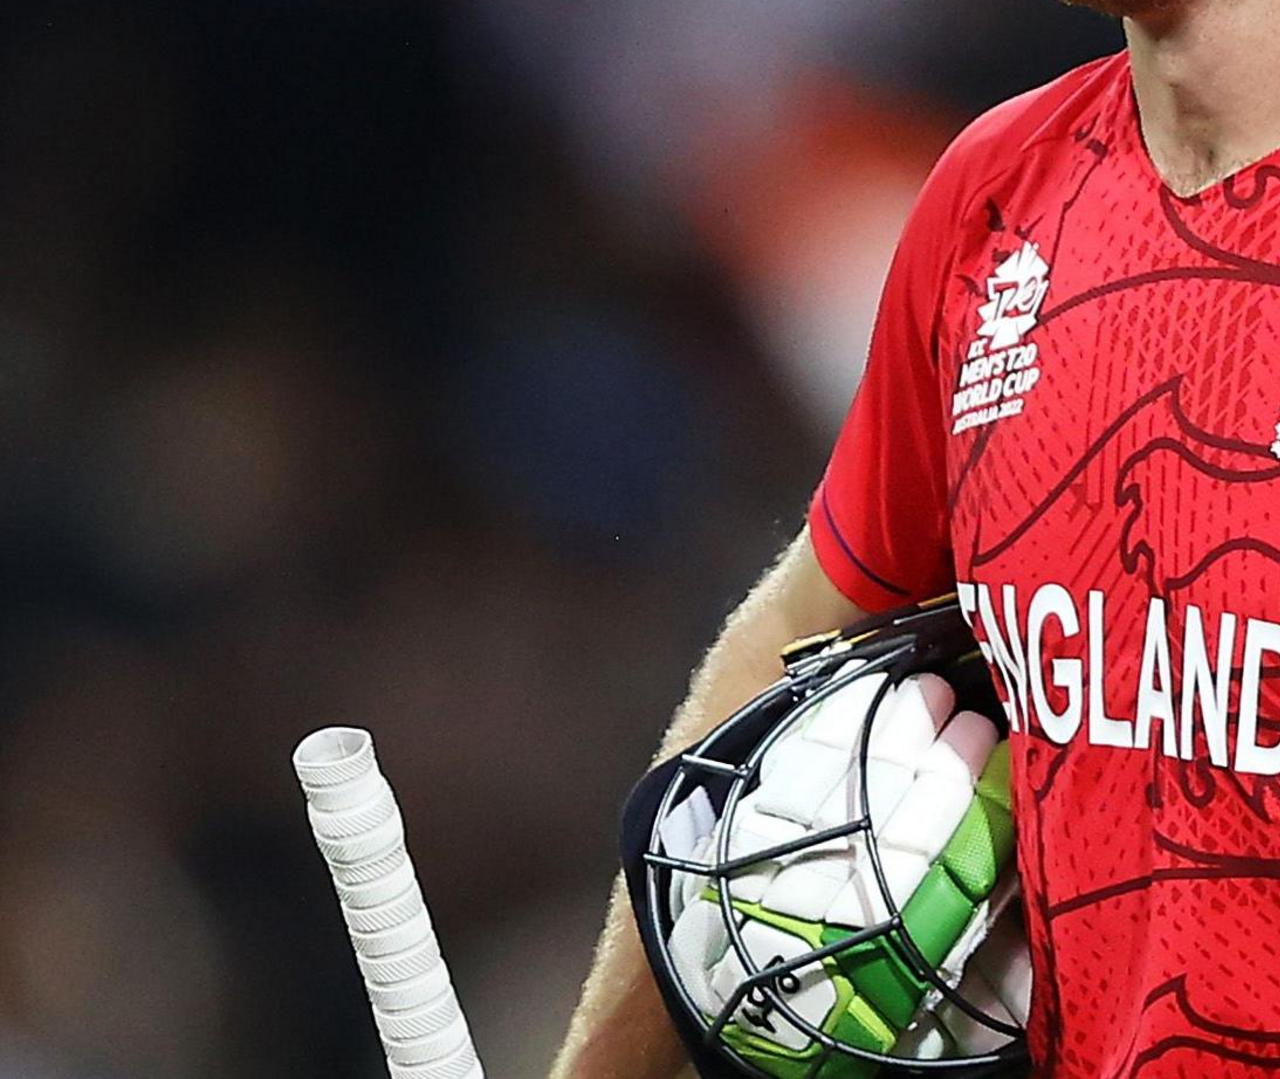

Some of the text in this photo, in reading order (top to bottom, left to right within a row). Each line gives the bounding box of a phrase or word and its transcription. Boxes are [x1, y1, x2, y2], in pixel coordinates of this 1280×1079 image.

[1006, 343, 1038, 372] T20
[952, 367, 1040, 417] WORLD CUP
